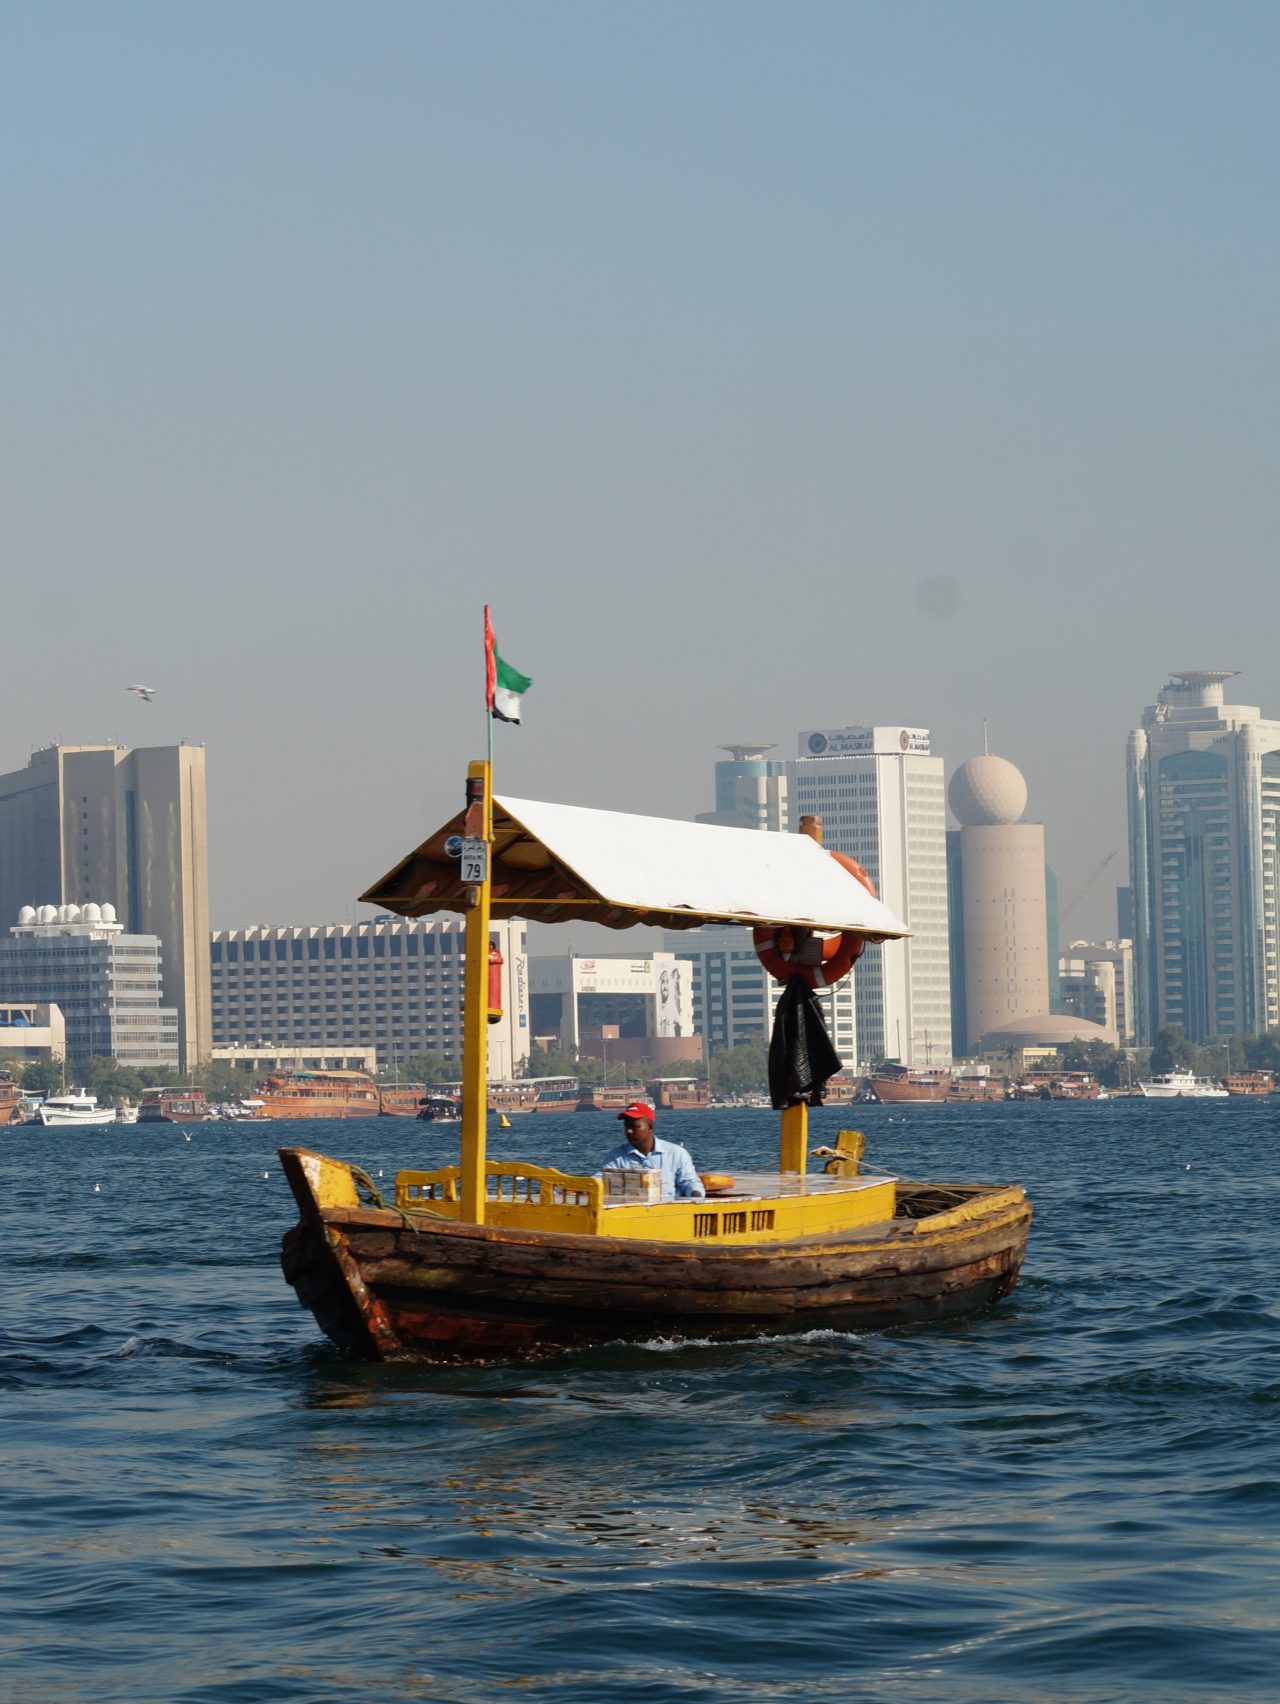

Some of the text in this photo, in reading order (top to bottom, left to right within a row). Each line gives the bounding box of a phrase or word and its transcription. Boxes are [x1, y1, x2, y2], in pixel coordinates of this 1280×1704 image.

[829, 742, 872, 752] AL MASRAF
[467, 863, 481, 878] 79
[516, 957, 527, 1012] Radisson
